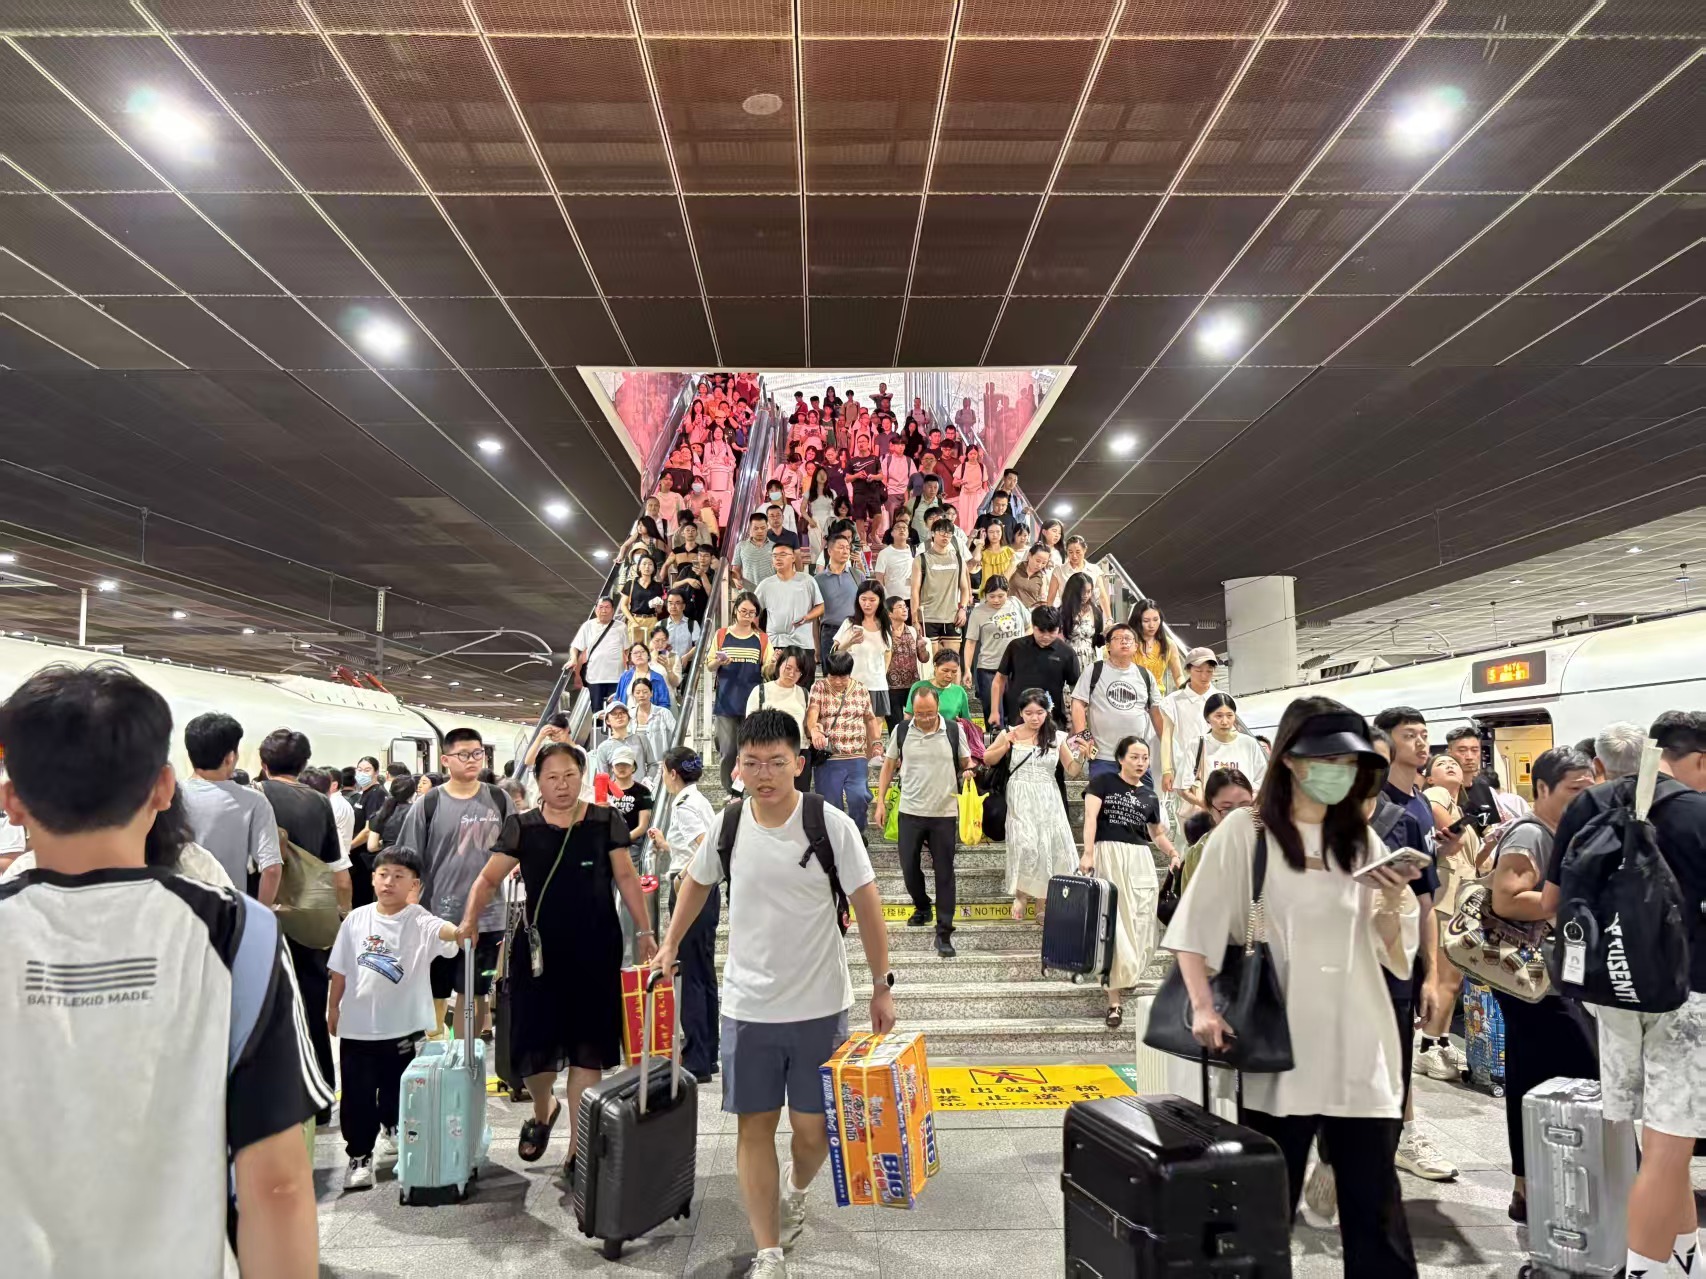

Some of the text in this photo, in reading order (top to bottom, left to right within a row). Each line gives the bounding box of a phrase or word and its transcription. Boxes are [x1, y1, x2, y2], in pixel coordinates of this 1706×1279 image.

[975, 906, 988, 916] NO
[27, 994, 104, 1007] BATTLEKID
[925, 1110, 938, 1165] BIG
[879, 1153, 904, 1199] BIG
